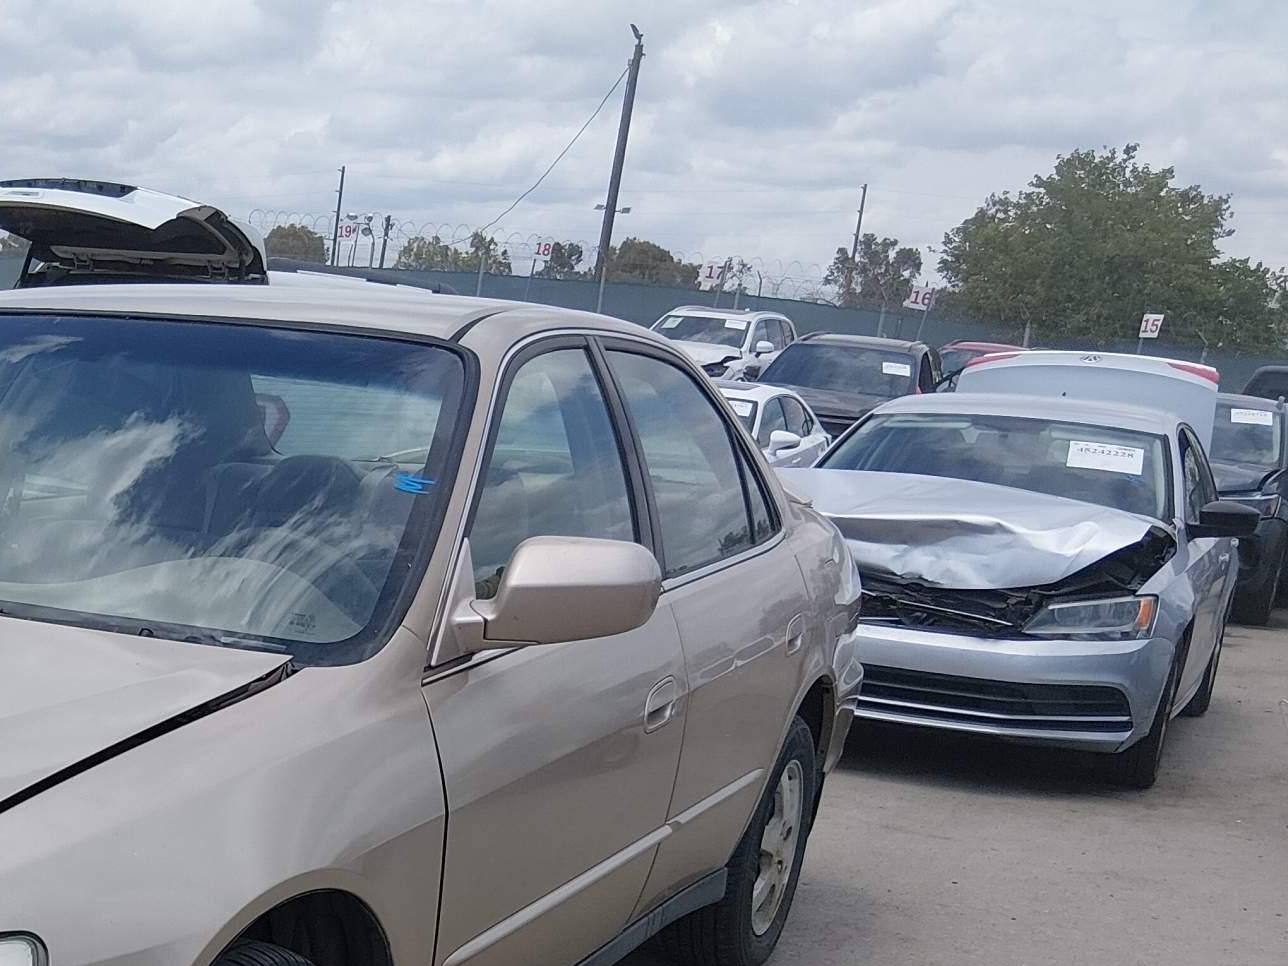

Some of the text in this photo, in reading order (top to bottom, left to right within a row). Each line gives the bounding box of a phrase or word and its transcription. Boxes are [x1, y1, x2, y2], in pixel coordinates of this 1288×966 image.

[339, 225, 352, 238] 19
[535, 242, 551, 256] 18
[705, 265, 724, 280] 17
[910, 290, 931, 306] 16
[1142, 318, 1161, 333] 15
